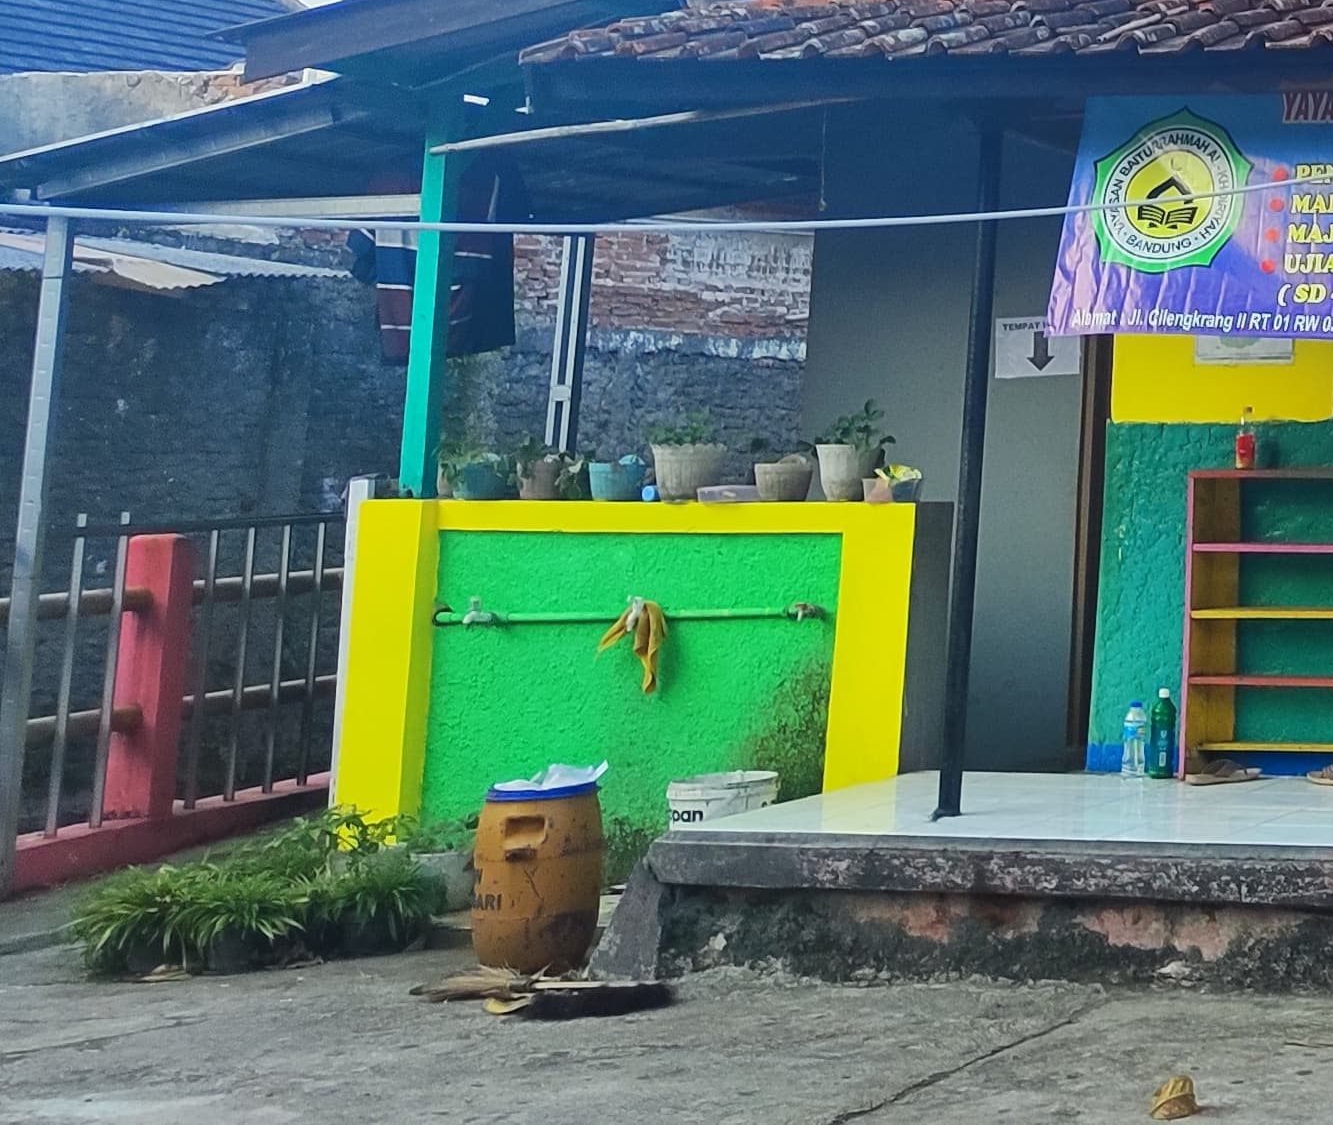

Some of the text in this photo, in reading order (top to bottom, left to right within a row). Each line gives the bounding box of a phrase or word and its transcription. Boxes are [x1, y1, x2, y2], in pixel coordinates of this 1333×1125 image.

[1120, 132, 1211, 177] BAITURRAHMAH
[1126, 234, 1192, 254] BANDUNG
[1293, 283, 1328, 304] SD
[1002, 322, 1040, 331] TEMPAT
[1072, 309, 1116, 327] Alamat
[1149, 309, 1233, 333] Cilengkrang
[1237, 313, 1247, 329] II
[1250, 314, 1271, 331] RT
[1273, 315, 1290, 332] 01
[1294, 315, 1321, 332] RW
